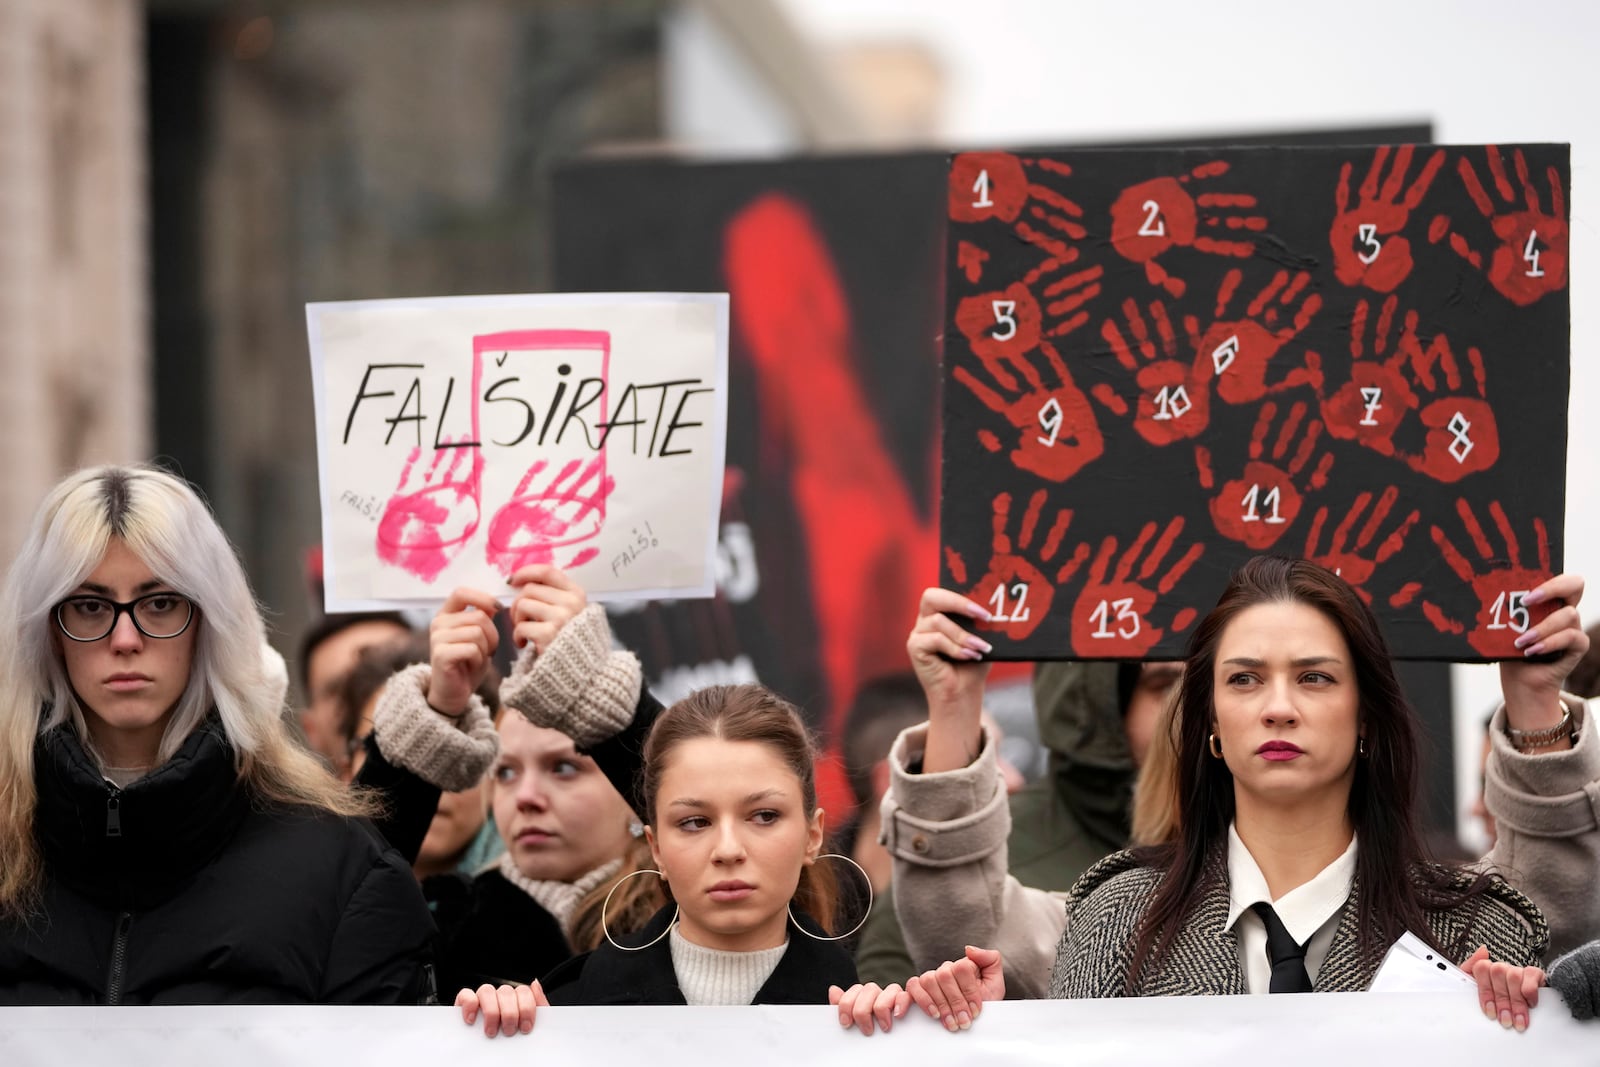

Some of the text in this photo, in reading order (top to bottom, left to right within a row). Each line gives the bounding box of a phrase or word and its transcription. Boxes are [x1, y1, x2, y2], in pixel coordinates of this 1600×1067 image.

[973, 170, 993, 207] 1
[1138, 200, 1164, 236] 2
[1359, 224, 1380, 264] 3
[1524, 230, 1544, 276] 4
[992, 301, 1016, 341] 5
[1212, 336, 1238, 374] 6
[1038, 398, 1063, 446] 9
[1154, 386, 1191, 419] 10
[1360, 388, 1381, 425] 7
[1448, 412, 1473, 463] 8
[1242, 484, 1285, 523] 11
[989, 584, 1029, 622] 12
[1089, 598, 1140, 639] 13
[1487, 590, 1531, 634] 15
